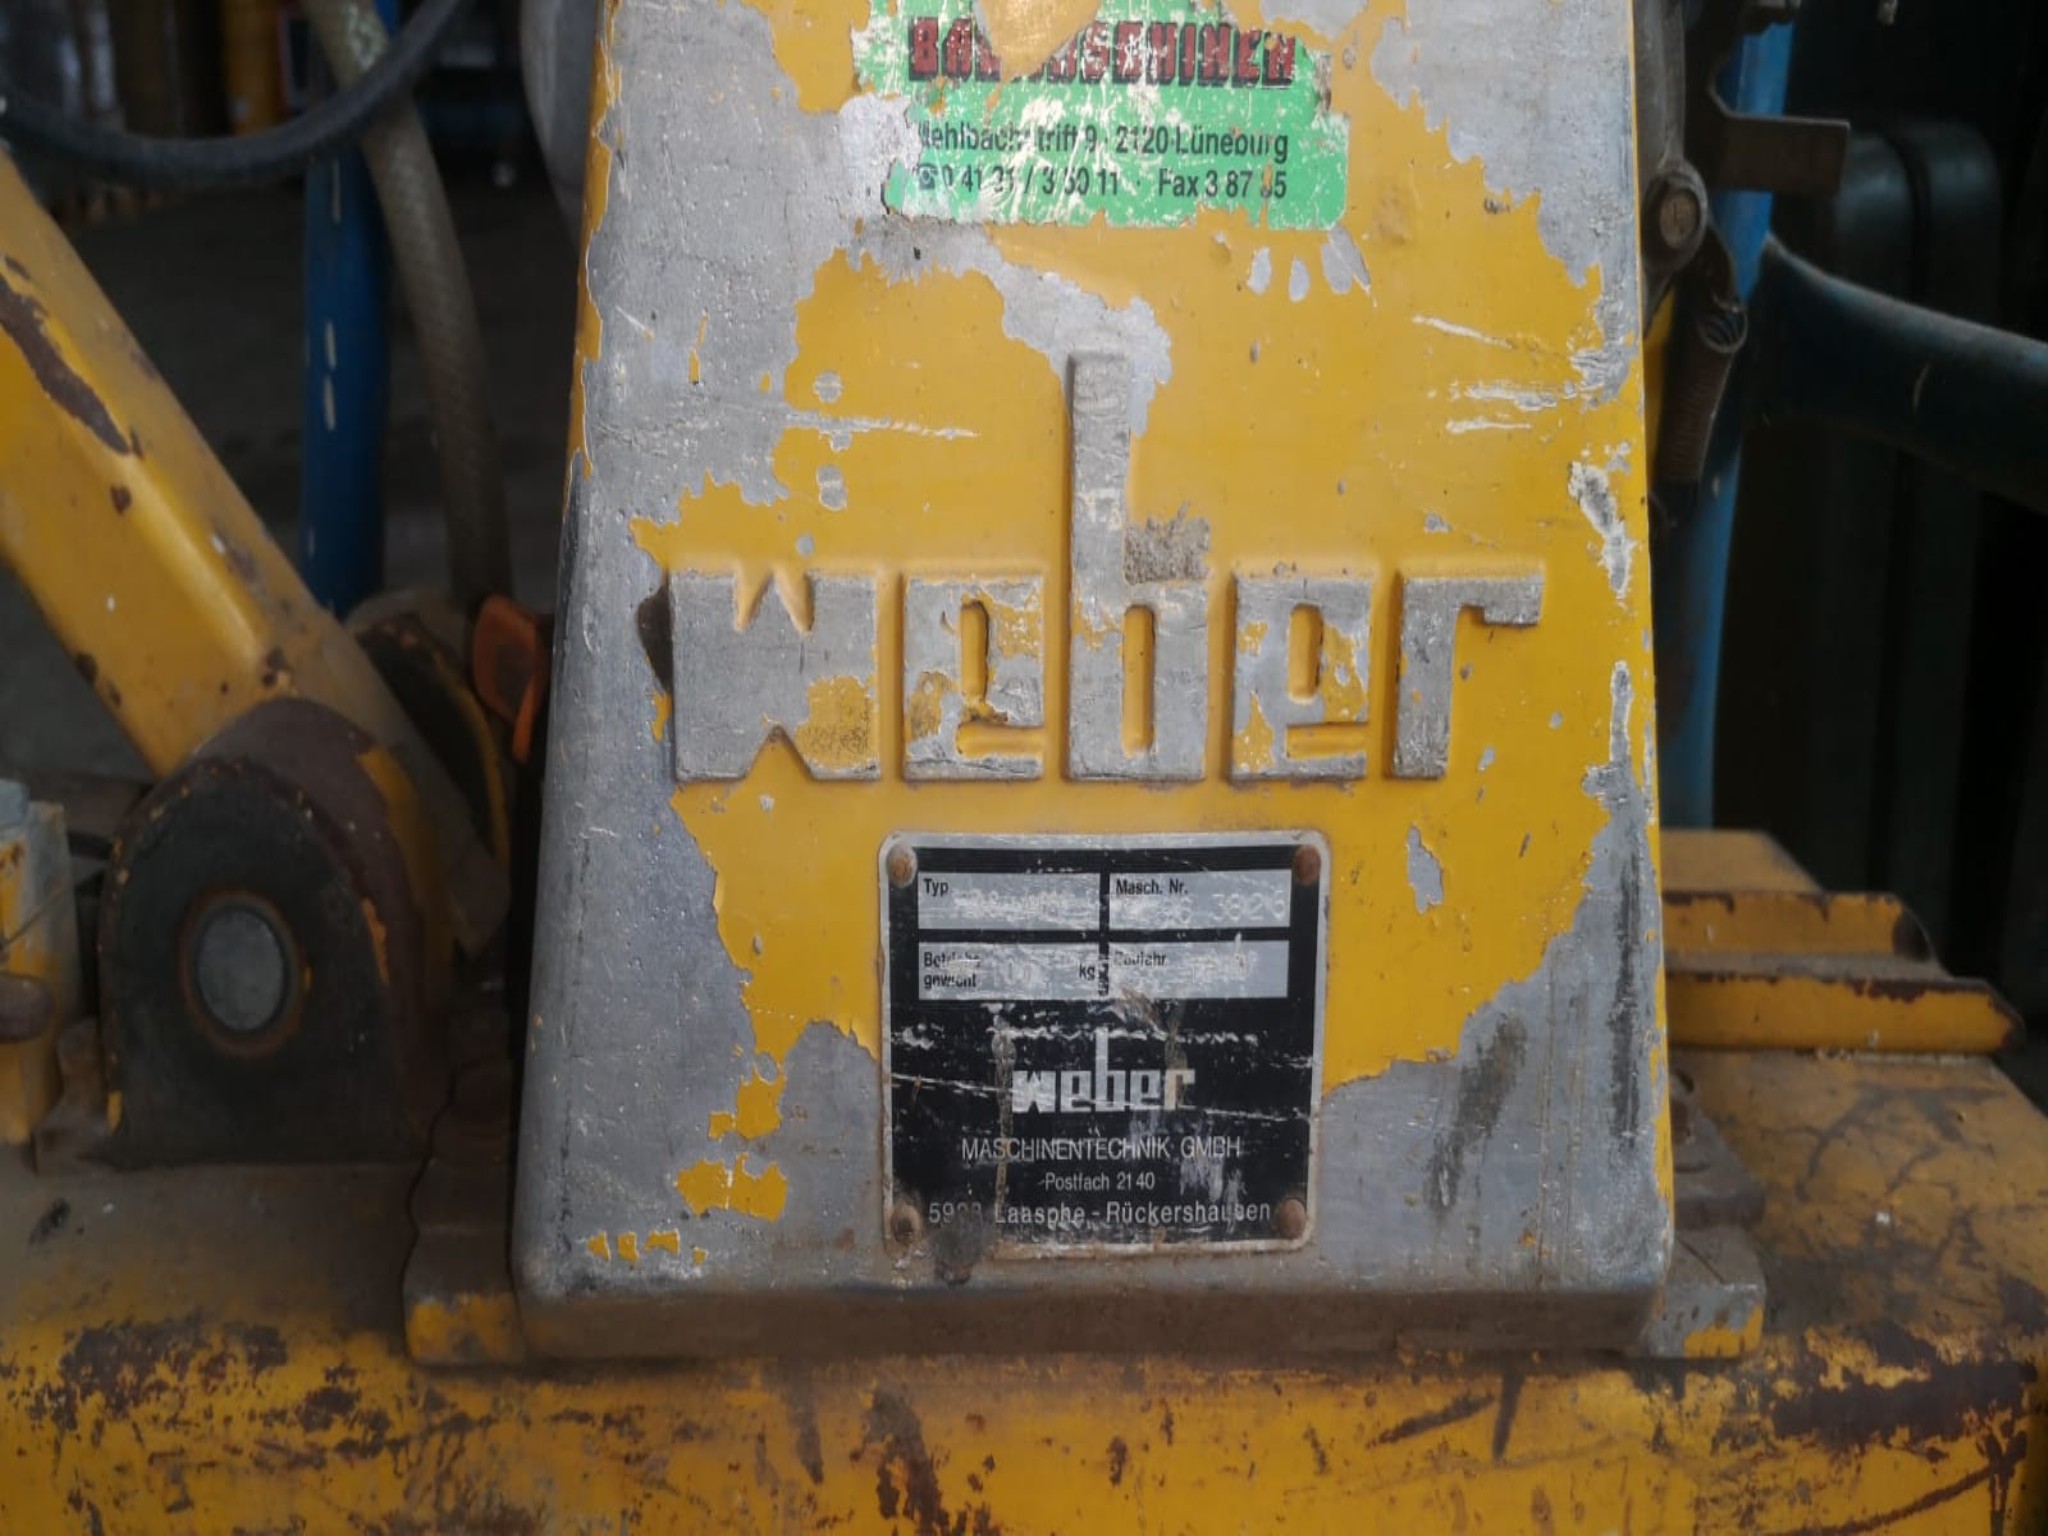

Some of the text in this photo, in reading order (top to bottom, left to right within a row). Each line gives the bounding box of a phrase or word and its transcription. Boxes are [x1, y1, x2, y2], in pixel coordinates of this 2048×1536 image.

[908, 17, 1296, 87] BASCHINEN
[1085, 124, 1097, 152] 9
[1176, 125, 1288, 164] Lüneburg
[1158, 168, 1199, 197] Fax
[669, 352, 1546, 781] weber
[924, 878, 949, 896] Typ
[1115, 878, 1189, 895] Masch. Nr.
[1079, 963, 1095, 980] kg
[1011, 1027, 1196, 1113] weber
[962, 1135, 1241, 1160] MASCHINENTECHNIK GMBH
[1045, 1171, 1110, 1191] Postfach
[995, 1202, 1085, 1231] Laasphe
